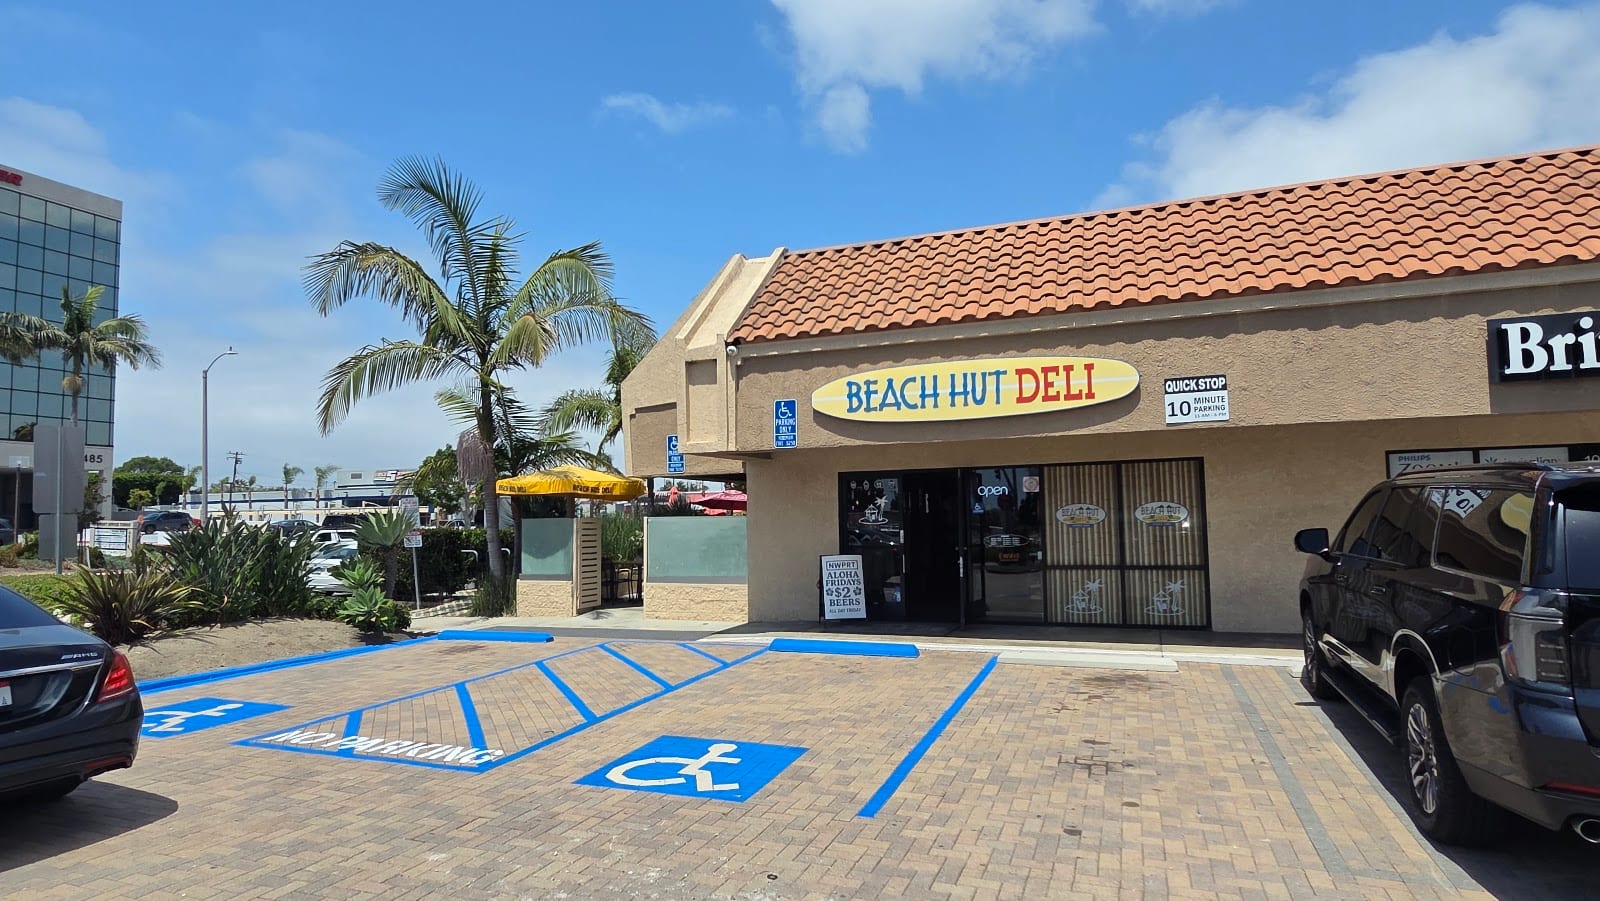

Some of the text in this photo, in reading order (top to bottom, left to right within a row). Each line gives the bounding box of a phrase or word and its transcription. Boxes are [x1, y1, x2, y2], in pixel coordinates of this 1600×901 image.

[1501, 316, 1600, 375] Bri
[846, 363, 1096, 414] BEACH HUT DELI
[1165, 376, 1226, 393] QUICK STOP
[1193, 395, 1226, 405] MINUTE
[1167, 400, 1192, 417] 10
[1193, 404, 1226, 413] PARKING
[775, 418, 796, 426] PARKING
[779, 426, 792, 434] ONLY
[1398, 454, 1432, 462] PHILIPS
[977, 485, 1008, 498] open
[1141, 505, 1181, 515] BEACH HUT
[828, 561, 856, 569] NWPRT
[827, 571, 859, 580] ALOHA
[834, 586, 851, 598] $2
[829, 598, 861, 607] BEERS
[263, 730, 504, 768] NO PARKING
